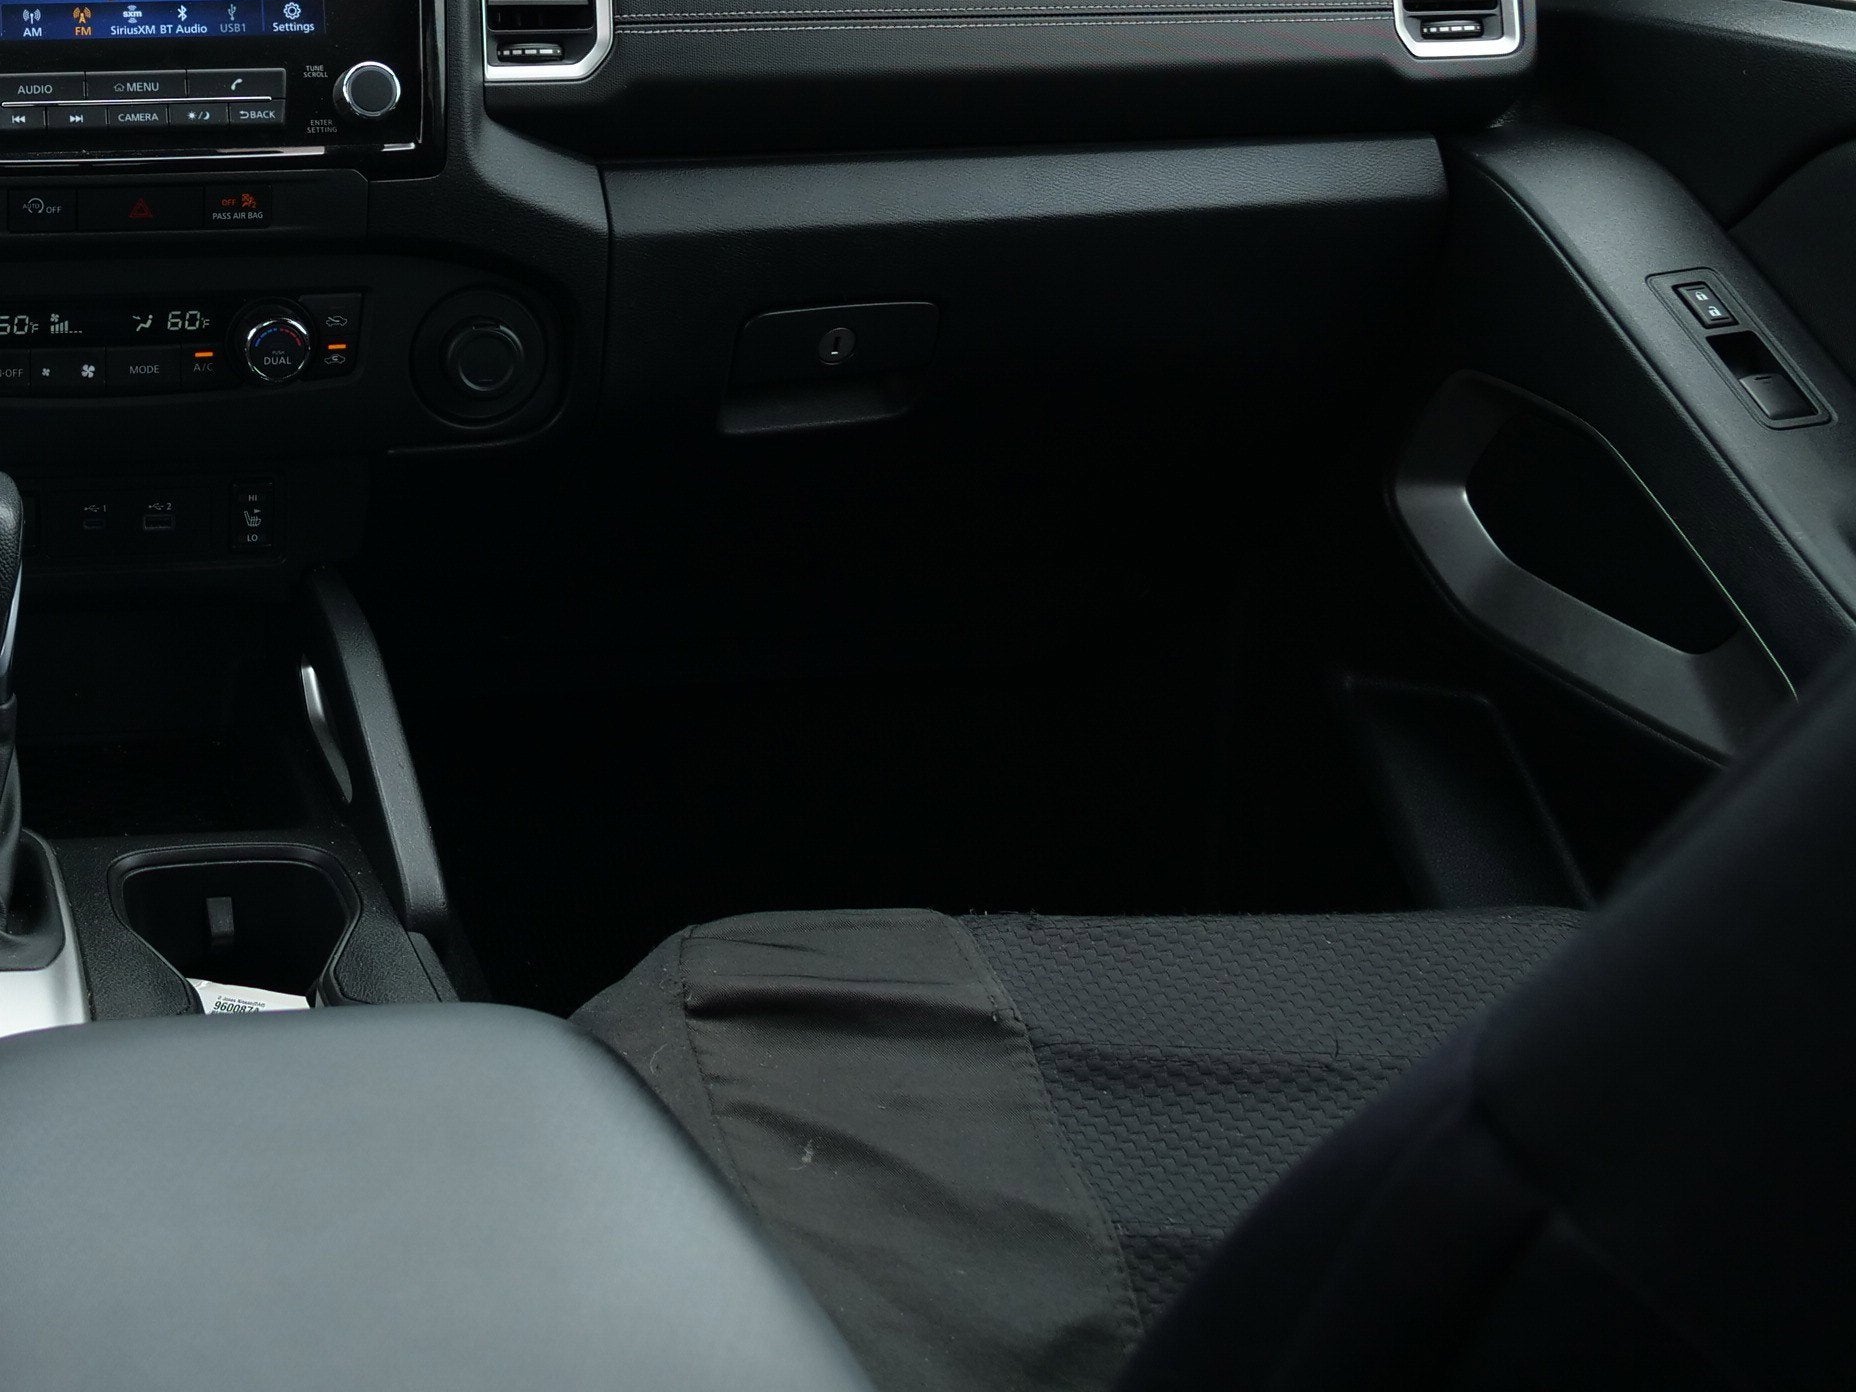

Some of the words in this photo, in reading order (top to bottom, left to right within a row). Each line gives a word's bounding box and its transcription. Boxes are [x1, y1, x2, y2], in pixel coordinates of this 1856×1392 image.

[22, 26, 43, 38] AM
[74, 25, 92, 37] FM
[110, 24, 156, 36] SiriusXM
[160, 23, 178, 35] BT
[180, 22, 208, 34] Audio
[219, 21, 247, 33] USB1
[272, 20, 315, 34] Settings
[302, 71, 329, 79] SCROLL
[17, 84, 53, 95] AUDIO
[125, 81, 160, 92] MENU
[117, 111, 159, 123] CAMERA
[249, 109, 276, 120] BACK
[309, 119, 334, 127] ENTER
[305, 126, 337, 134] SETTING
[221, 198, 237, 207] OFF
[45, 205, 62, 214] OFF
[212, 212, 231, 220] PASS
[233, 211, 245, 220] AIR
[246, 211, 264, 220] BAG
[263, 356, 292, 366] DUAL
[129, 364, 160, 375] MODE
[193, 361, 214, 373] A/C
[248, 494, 258, 502] HI
[246, 534, 258, 542] LO
